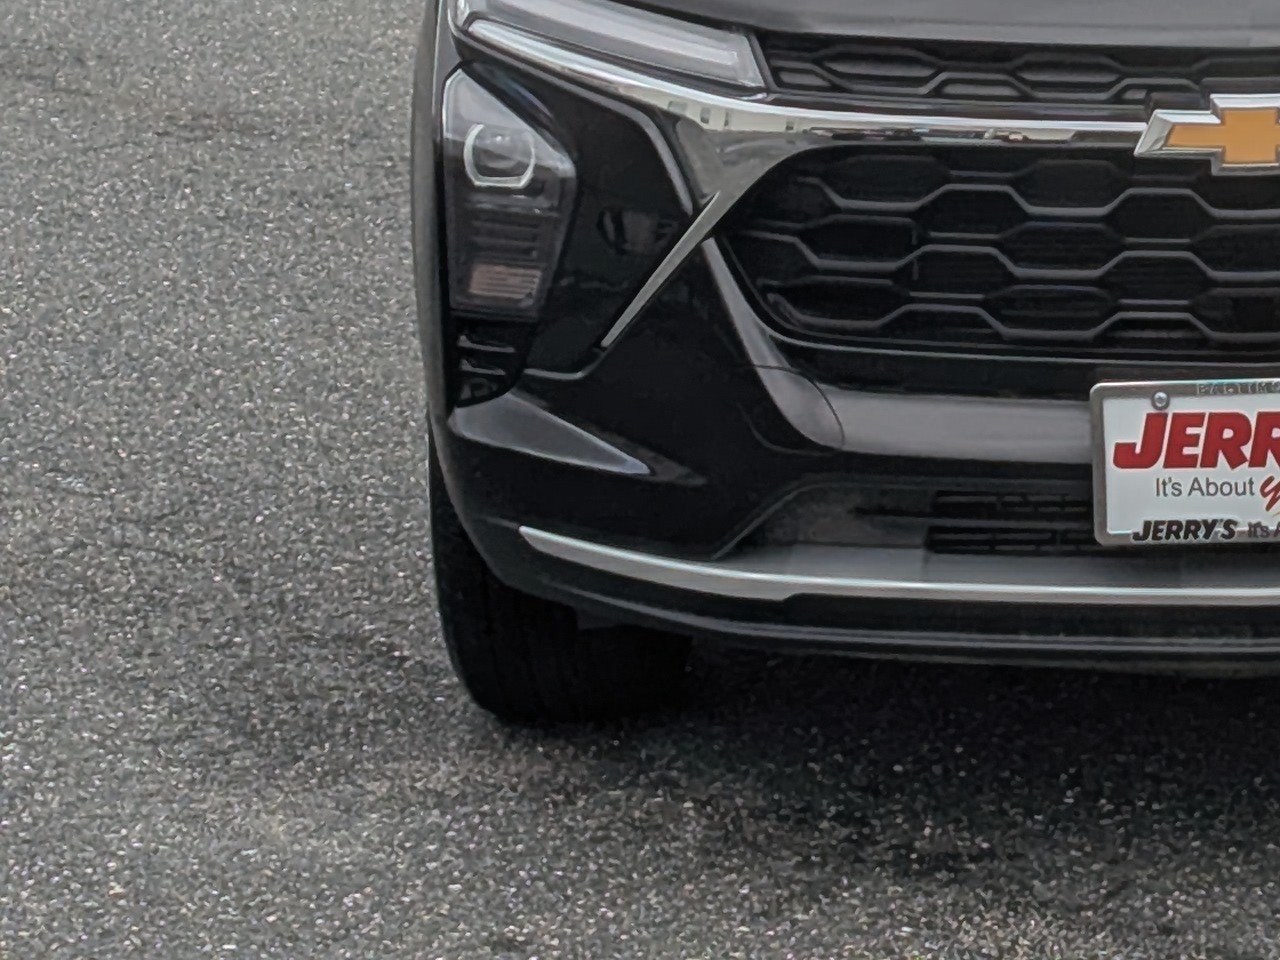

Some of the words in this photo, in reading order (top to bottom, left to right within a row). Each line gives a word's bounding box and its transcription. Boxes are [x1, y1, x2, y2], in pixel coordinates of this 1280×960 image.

[1155, 476, 1182, 497] It's
[1189, 478, 1255, 497] About
[1132, 518, 1239, 542] JERRY'S
